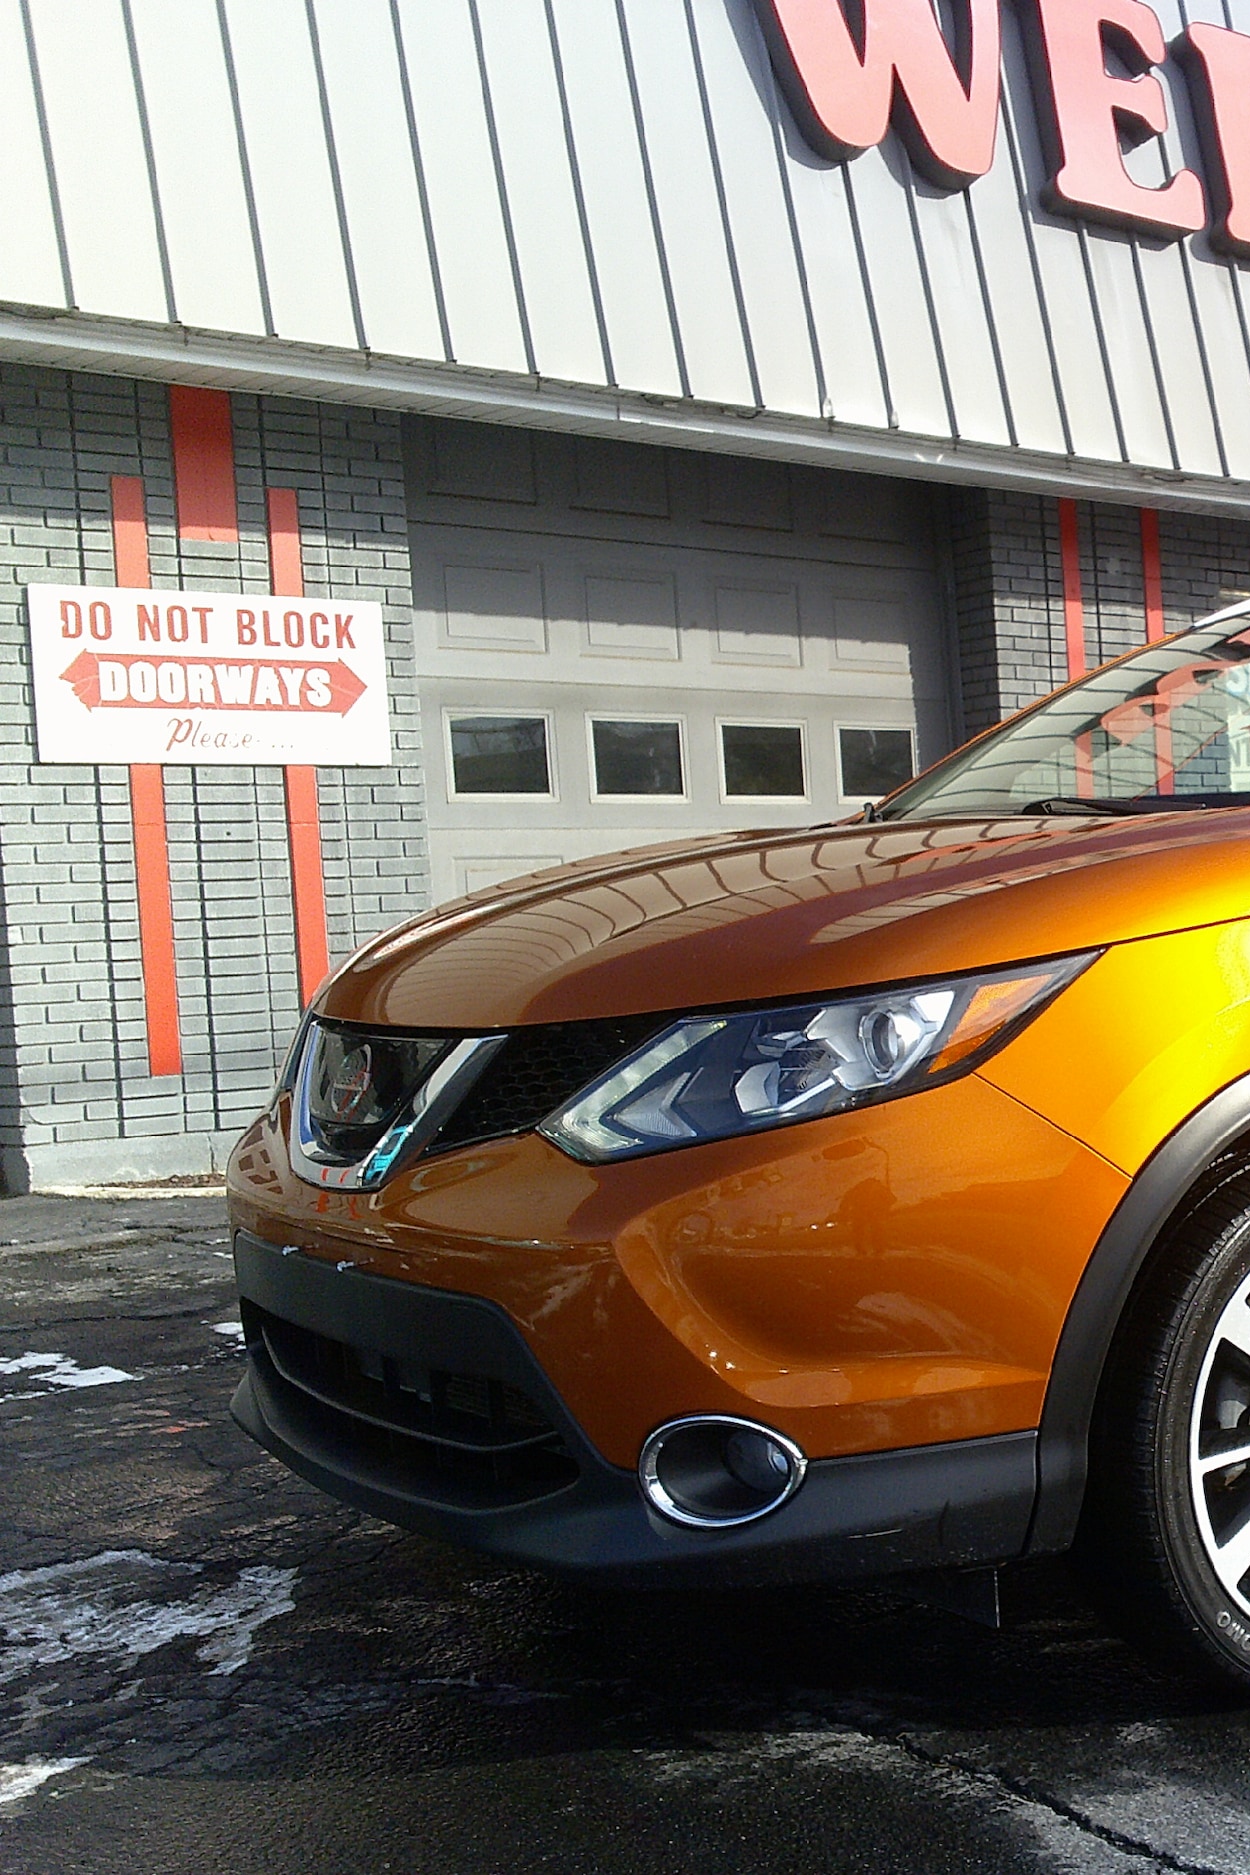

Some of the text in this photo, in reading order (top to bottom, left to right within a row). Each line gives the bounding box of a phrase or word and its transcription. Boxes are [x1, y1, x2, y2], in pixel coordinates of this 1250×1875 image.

[60, 600, 356, 649] DO NOT BLOCK
[98, 660, 332, 708] DOORWAYS
